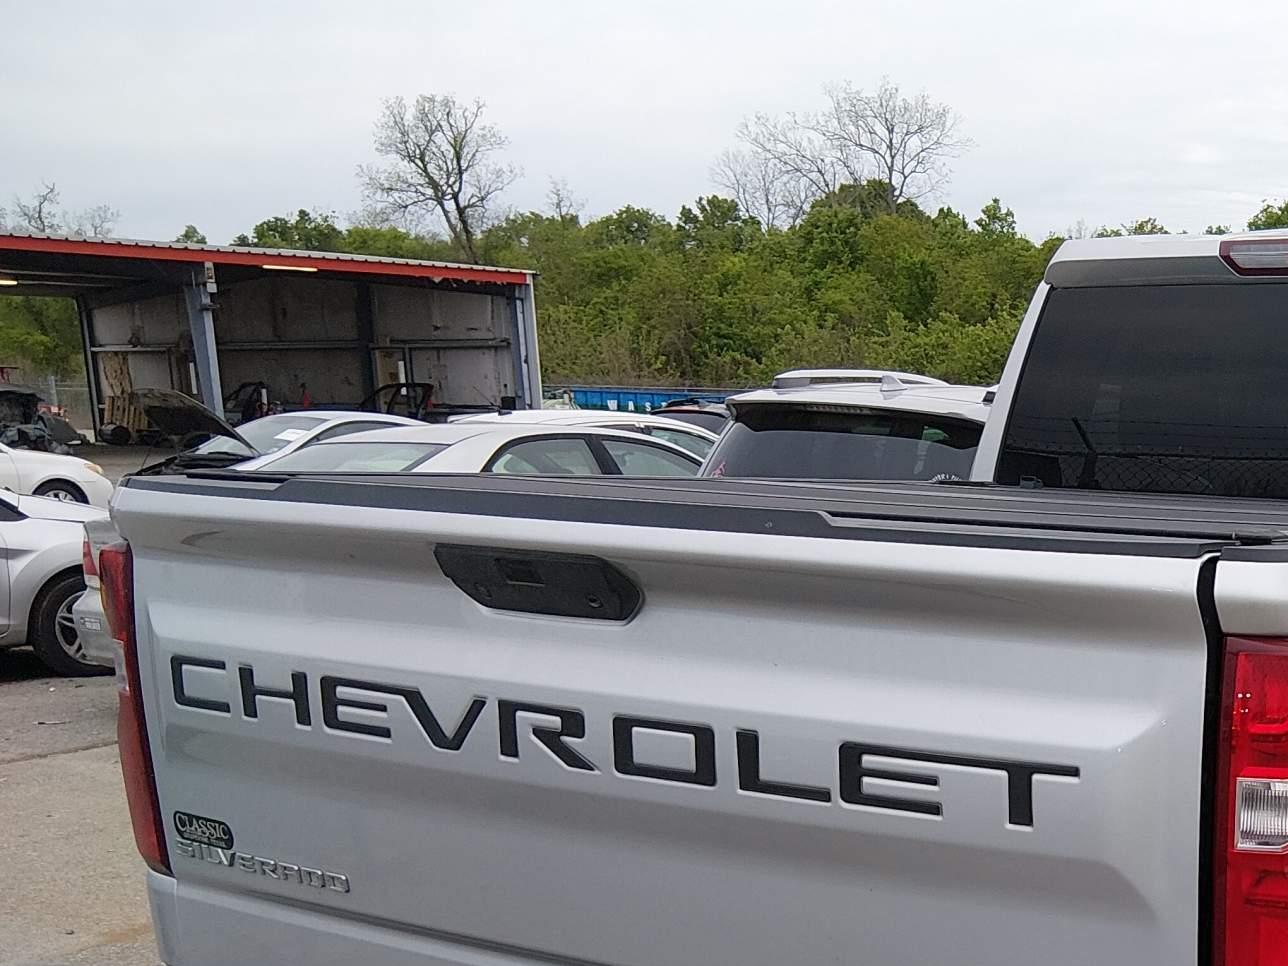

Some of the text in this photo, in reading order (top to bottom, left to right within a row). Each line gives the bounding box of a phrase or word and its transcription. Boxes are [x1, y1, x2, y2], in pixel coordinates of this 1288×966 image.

[171, 655, 1080, 828] CHEVROLET
[176, 813, 229, 839] CLASSIC
[176, 838, 350, 893] SILVERADO
